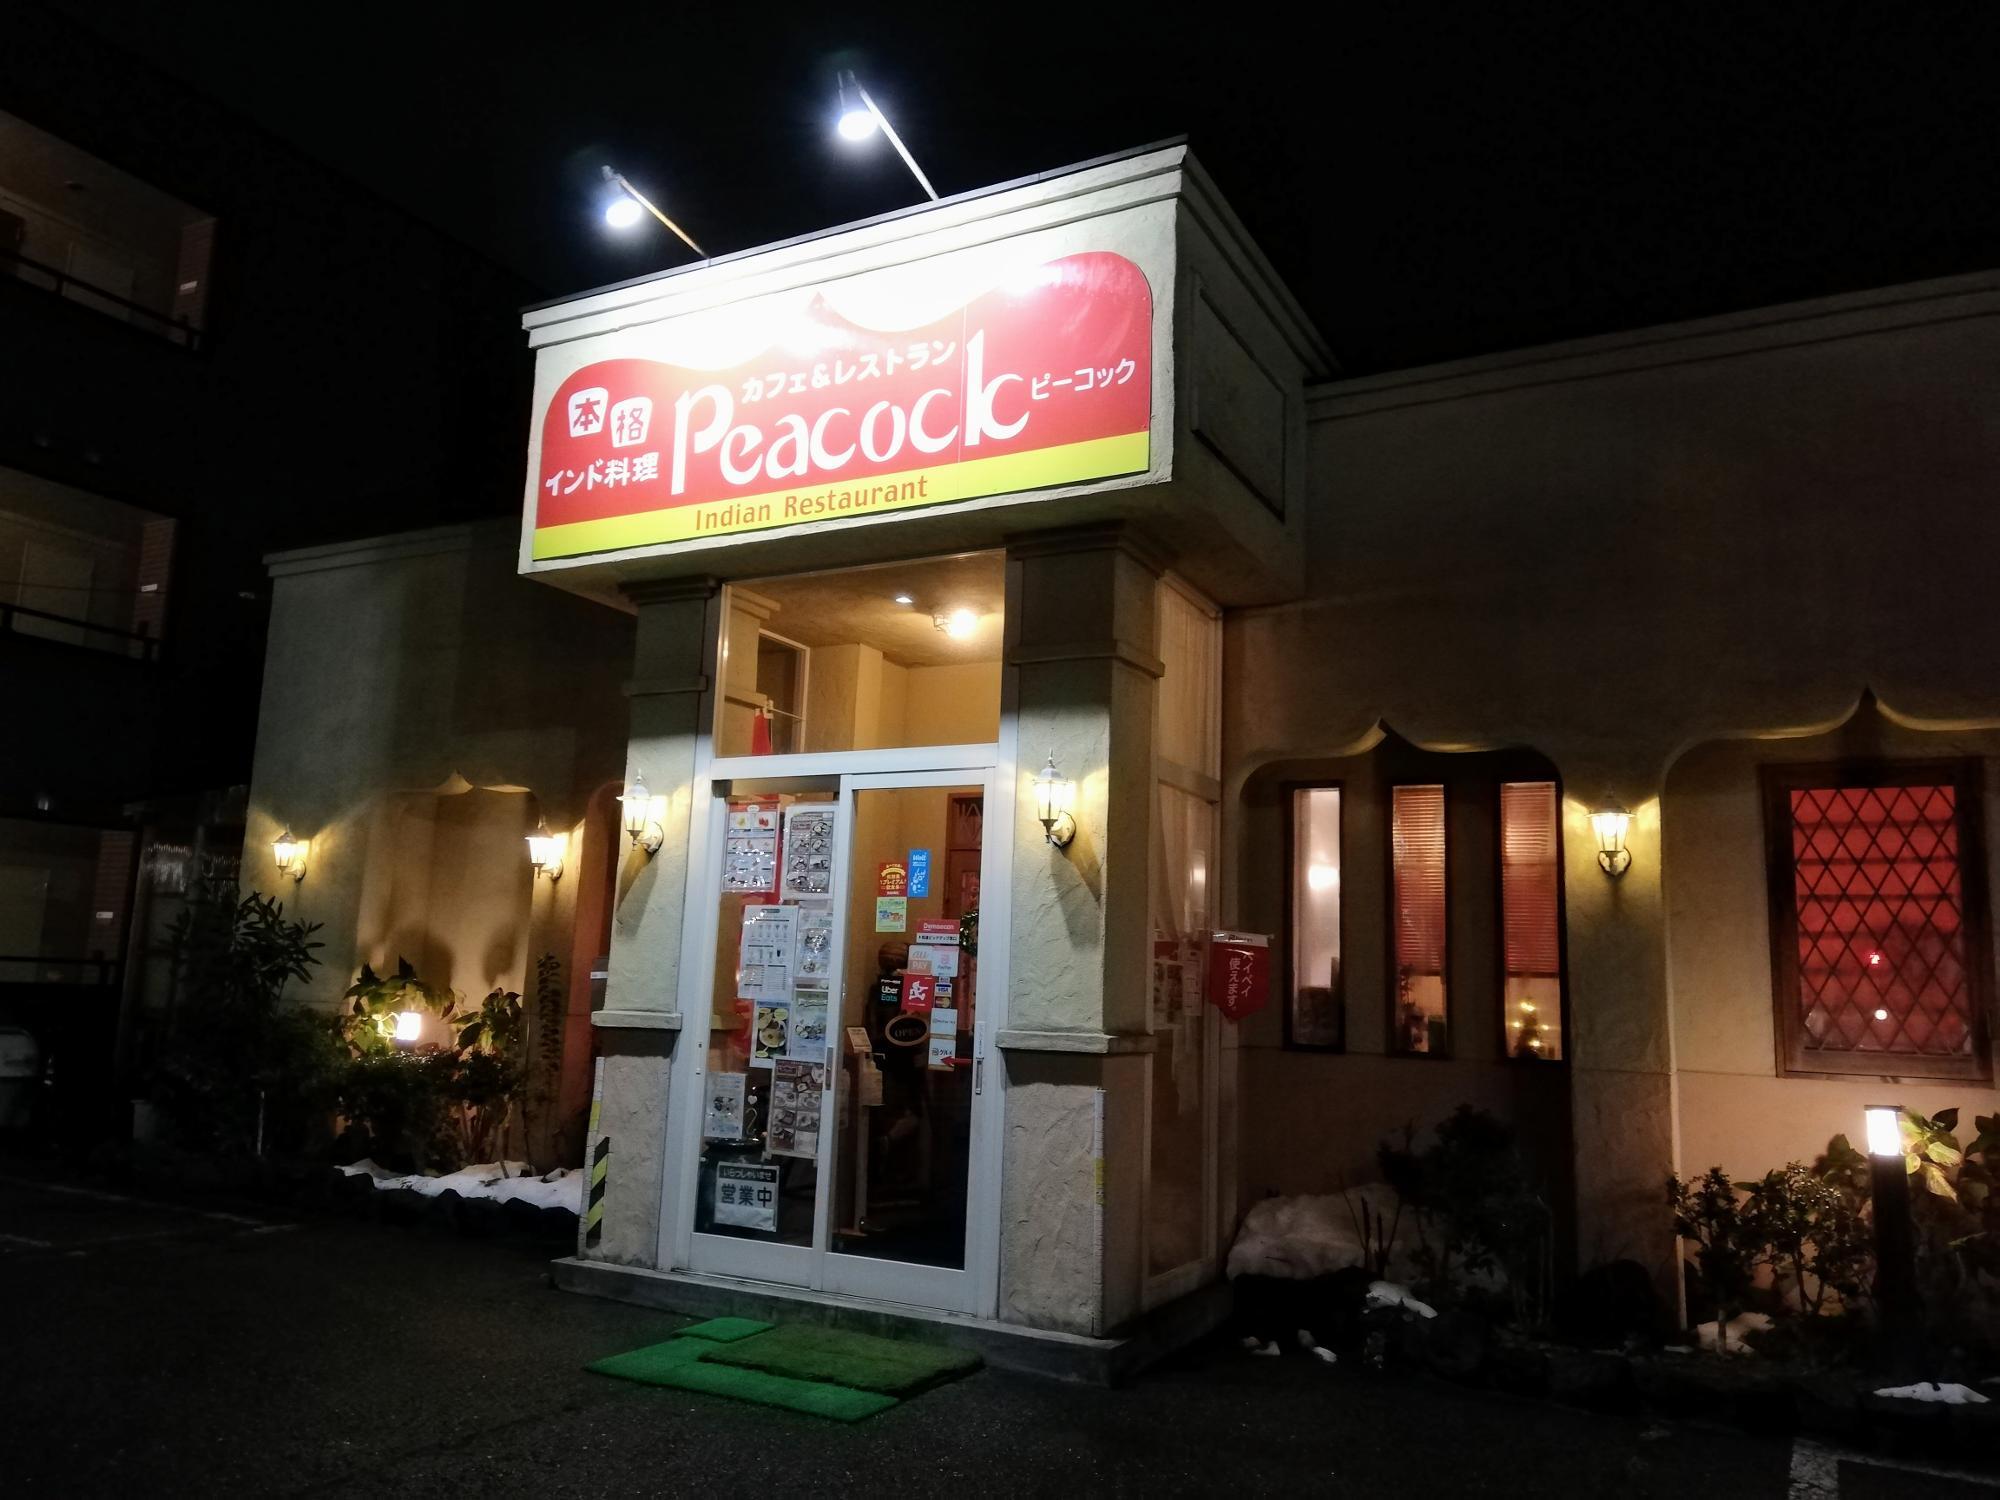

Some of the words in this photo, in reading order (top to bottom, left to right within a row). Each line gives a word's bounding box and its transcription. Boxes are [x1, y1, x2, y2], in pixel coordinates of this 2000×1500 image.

[741, 341, 957, 404] カフェ&レストラン
[1032, 358, 1136, 400] ピーコック
[571, 396, 646, 444] 本格
[671, 329, 1030, 496] Peacock
[545, 452, 660, 497] インド料理
[695, 502, 771, 532] Indian
[784, 475, 929, 518] Restaurant
[881, 985, 899, 994] Uber
[881, 993, 898, 1002] Eats
[721, 1183, 772, 1208] 営業中
[724, 1168, 772, 1180] いらっしゃいませ
